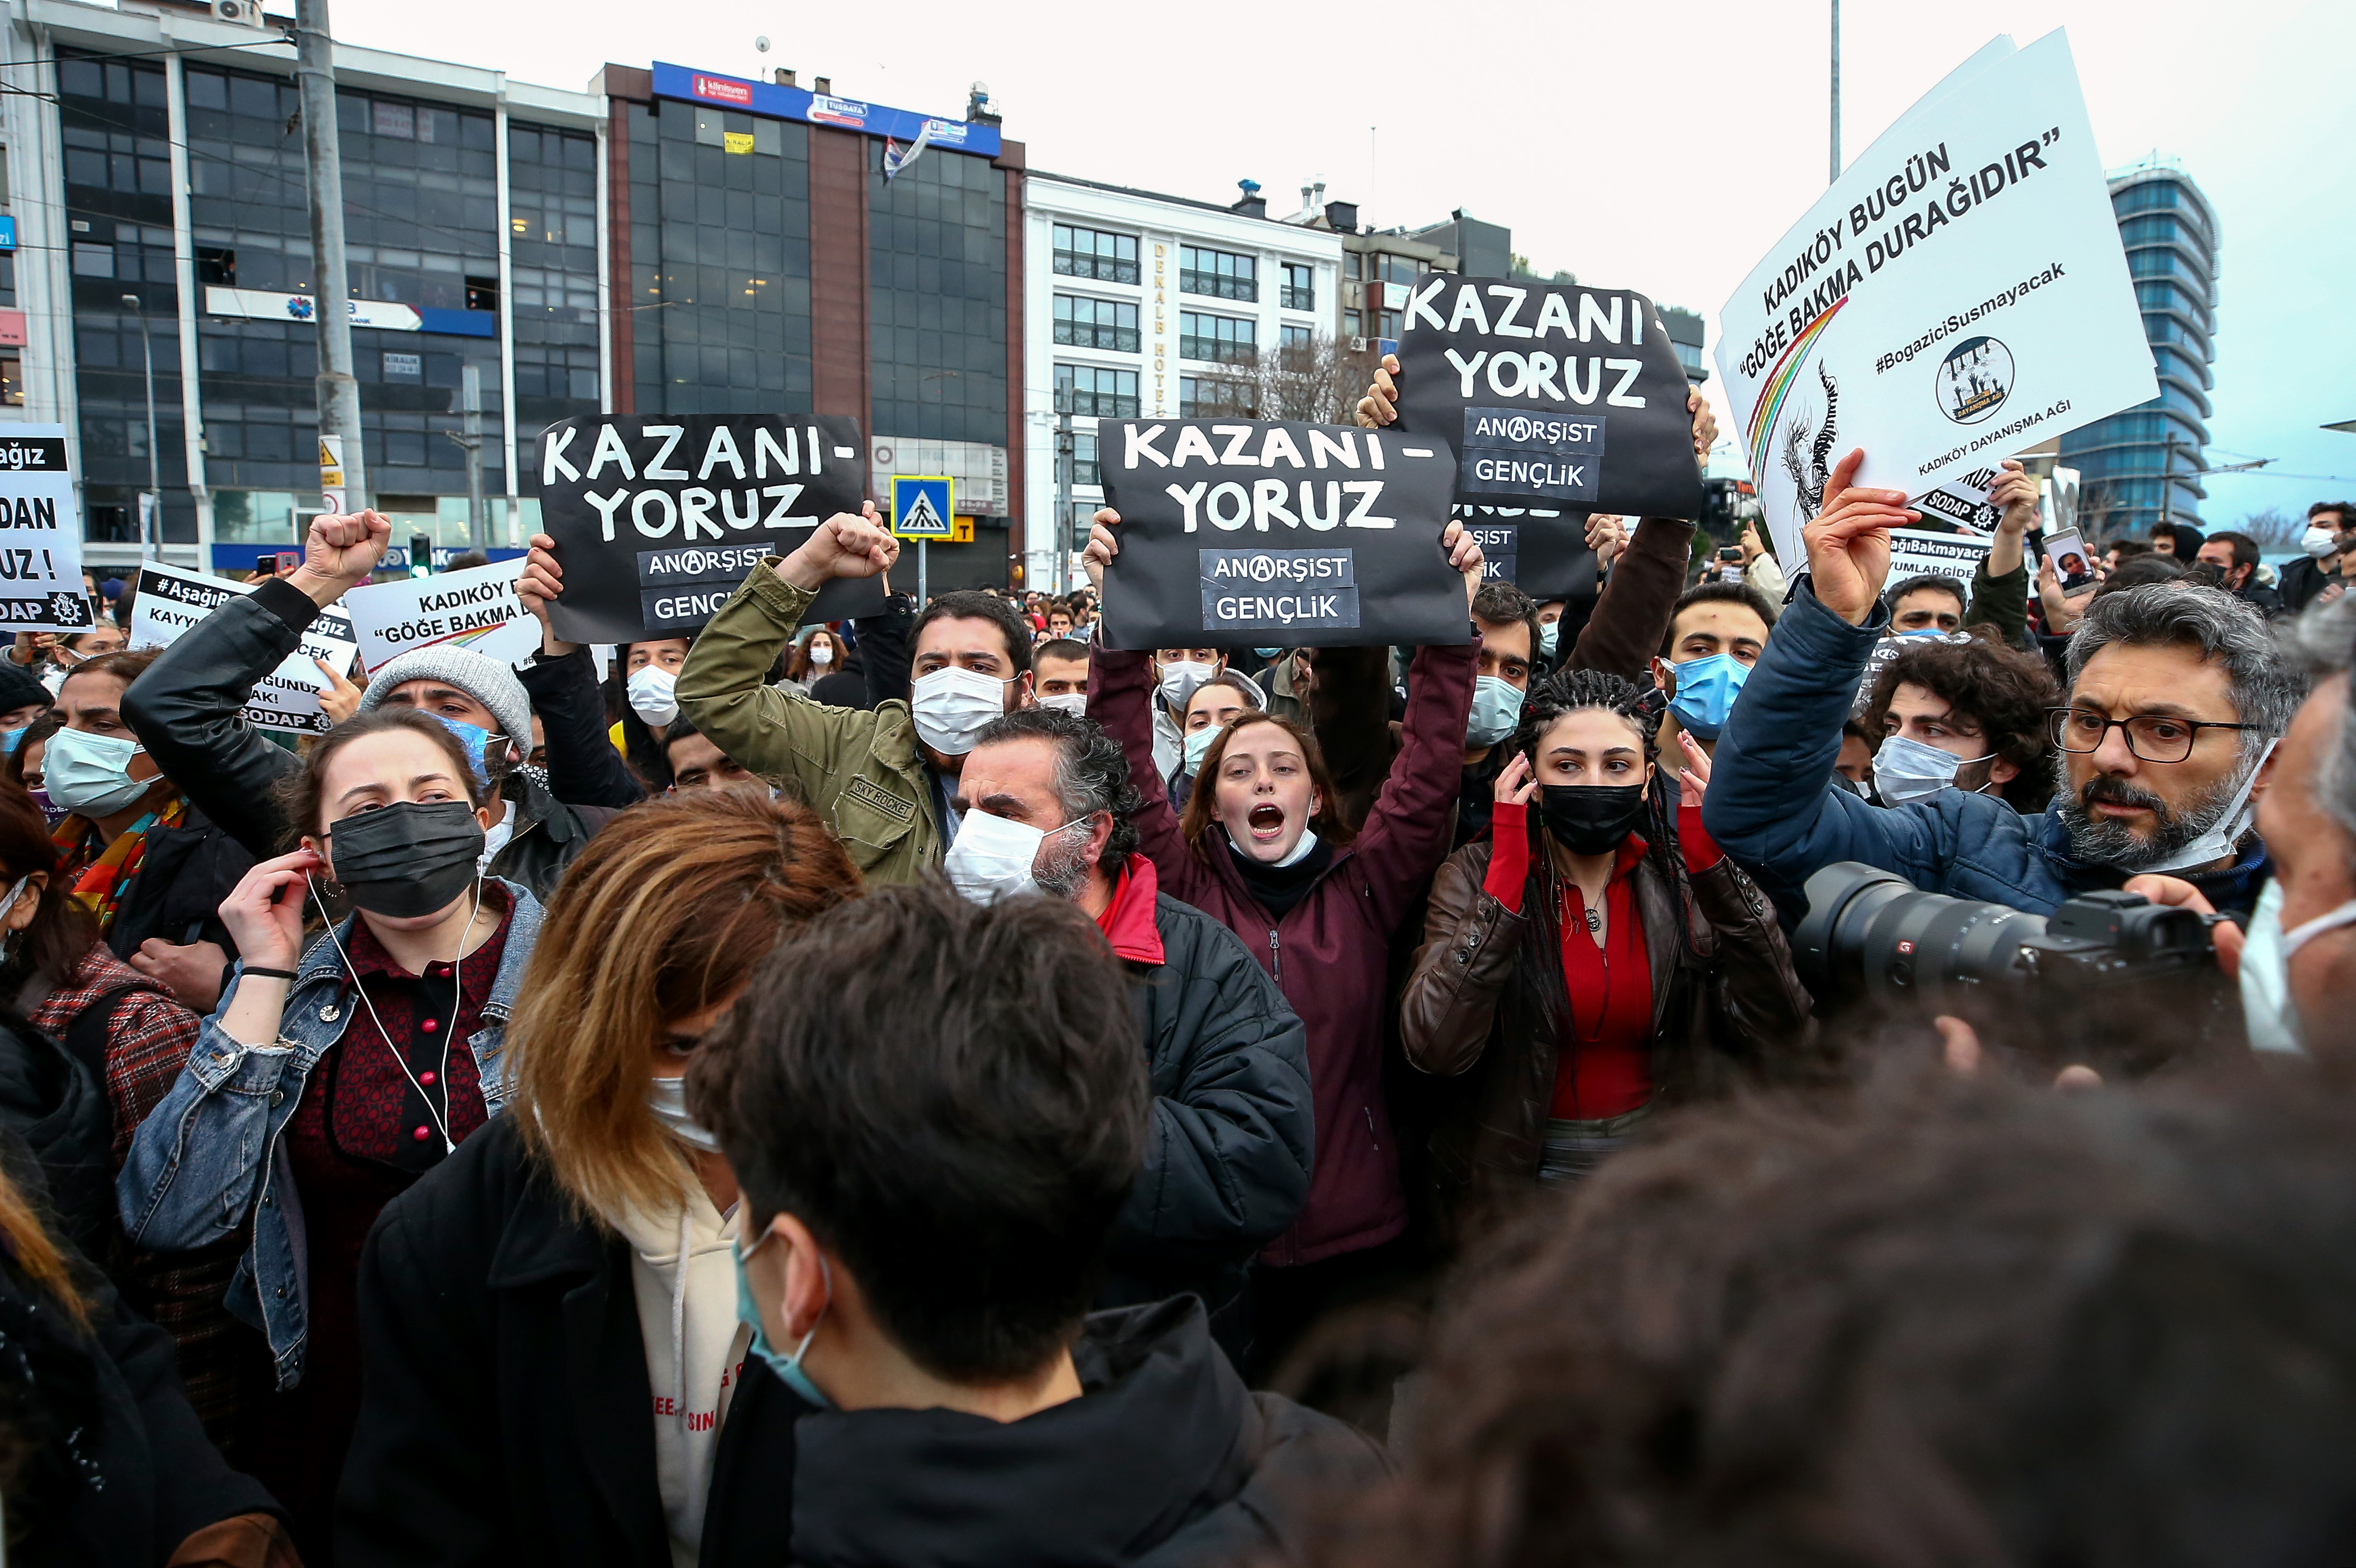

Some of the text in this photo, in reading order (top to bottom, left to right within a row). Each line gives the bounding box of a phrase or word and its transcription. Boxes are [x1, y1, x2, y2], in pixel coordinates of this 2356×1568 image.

[1739, 126, 2060, 379] “GÖĞE BAKMA DURAĞIDIR”
[1763, 142, 1951, 317] KADIKÖY BUGÜN
[1875, 262, 2066, 375] #BogaziciSusmayacak
[1154, 342, 1165, 418] HOTEL
[1444, 348, 1646, 408] YORUZ
[1918, 399, 2073, 477] KADIKÖY DAYANIŞMA AĞI
[583, 483, 820, 542] YORUZ
[1164, 480, 1397, 533] YORUZ
[1929, 491, 1971, 517] SODAP
[374, 619, 445, 643] “GÖĞE
[449, 604, 517, 632] BAKMA
[419, 581, 504, 613] KADIKÖY
[855, 783, 911, 816] SKY ROCKET
